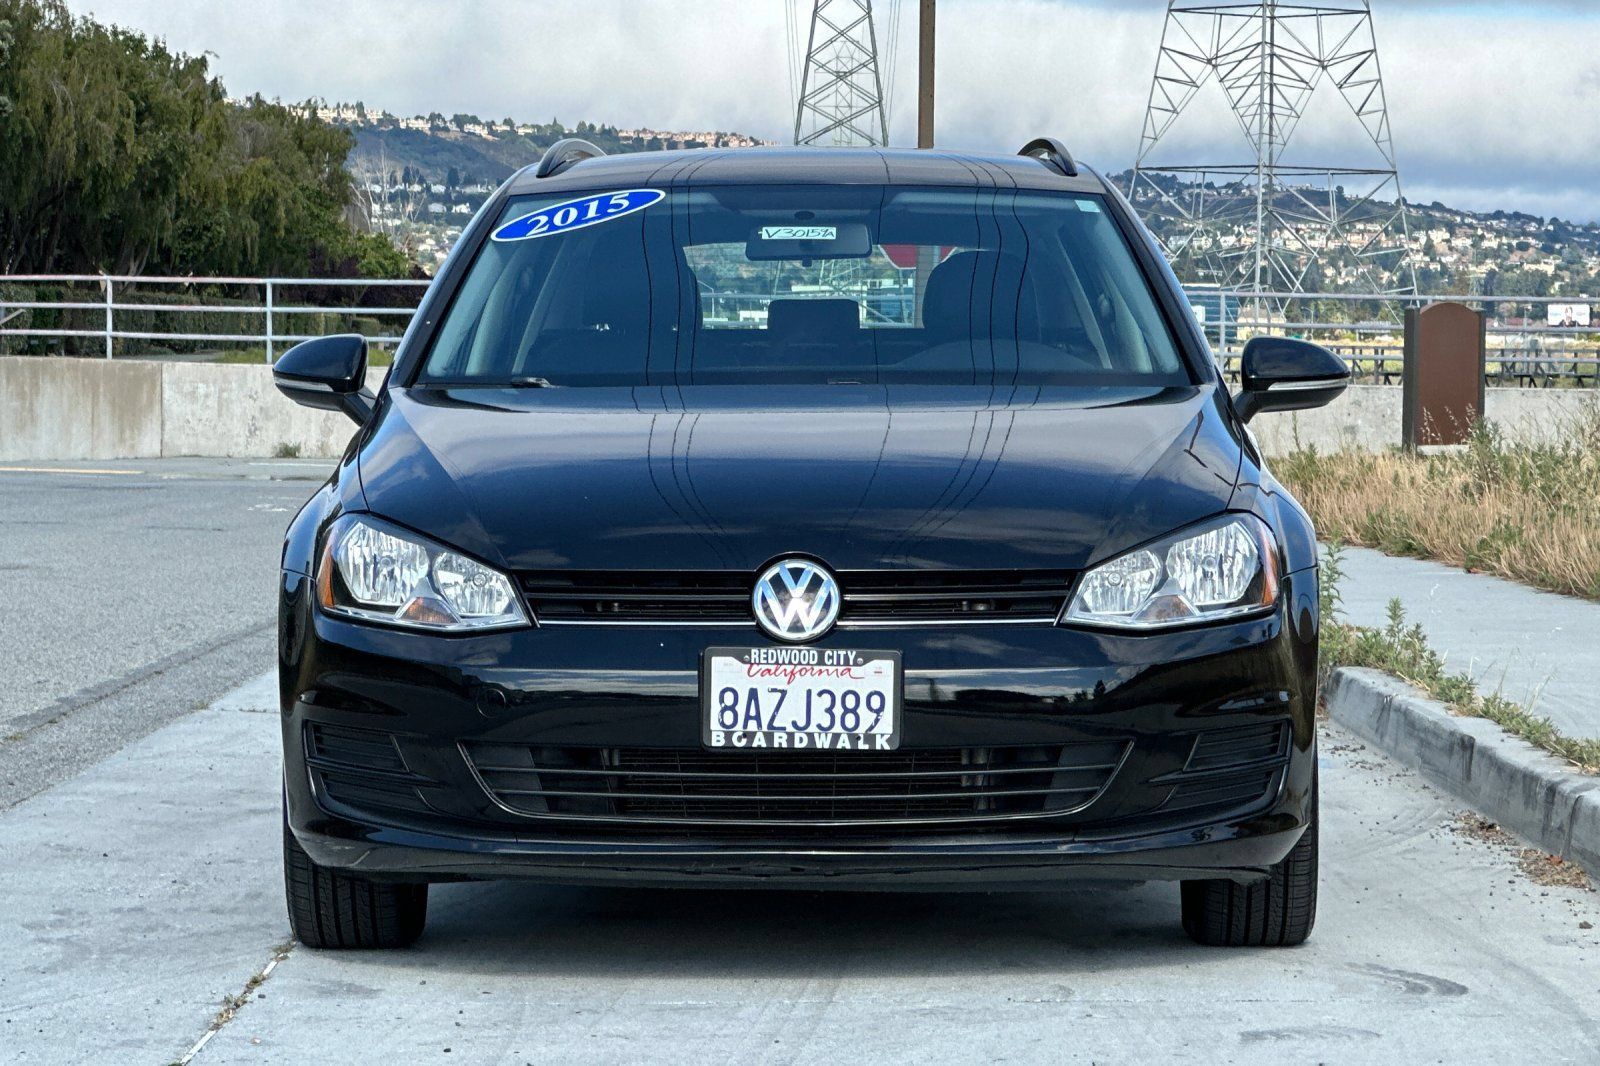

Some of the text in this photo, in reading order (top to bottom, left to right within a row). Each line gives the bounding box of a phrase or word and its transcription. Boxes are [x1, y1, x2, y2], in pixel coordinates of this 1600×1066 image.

[526, 193, 630, 237] 2015
[756, 561, 836, 636] VW
[751, 649, 856, 665] REDWOOD CITY
[747, 664, 865, 685] California
[718, 687, 886, 732] 8AZJ389
[711, 731, 891, 750] BOARDWALK
